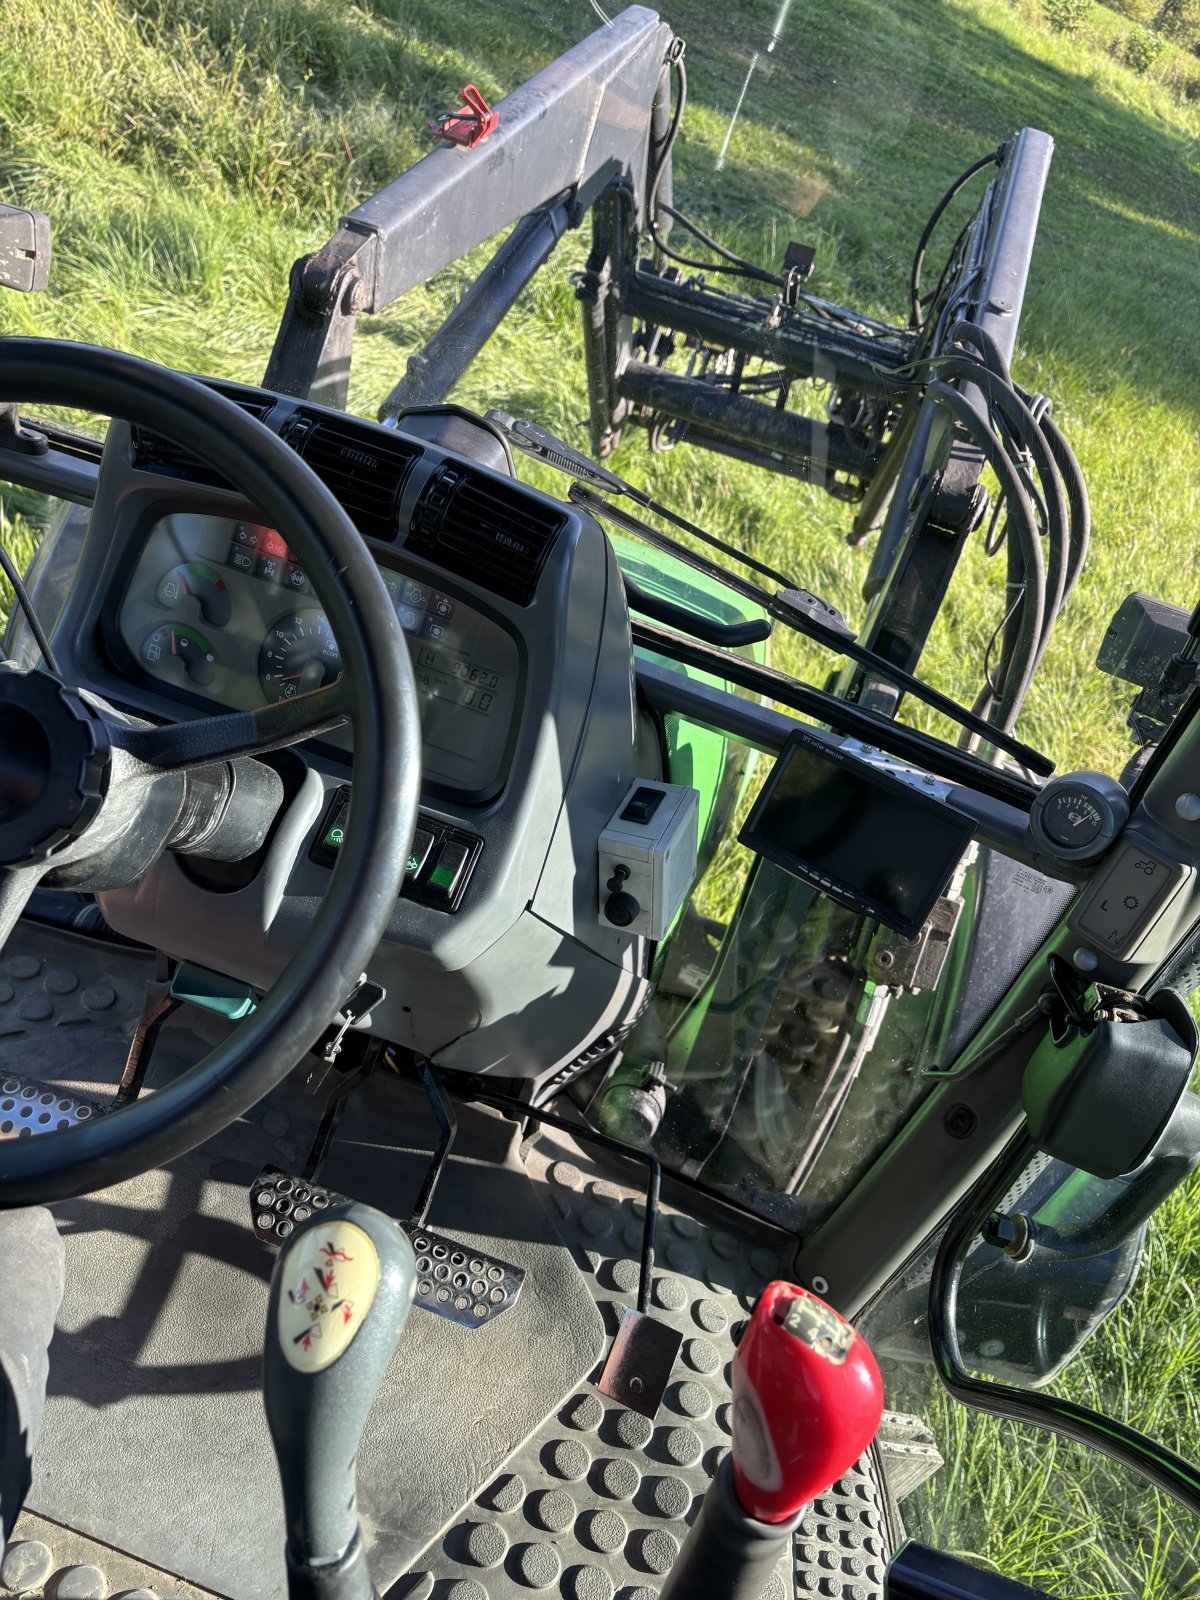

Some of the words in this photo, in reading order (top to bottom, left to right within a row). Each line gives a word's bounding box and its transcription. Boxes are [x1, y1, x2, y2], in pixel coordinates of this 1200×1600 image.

[294, 616, 303, 625] 12
[275, 630, 284, 638] 10
[267, 650, 272, 658] 8
[322, 649, 338, 659] econ
[265, 673, 271, 681] 6
[825, 747, 845, 761] monitor
[1100, 899, 1108, 912] L
[788, 1313, 801, 1328] 2
[807, 1327, 819, 1342] 4
